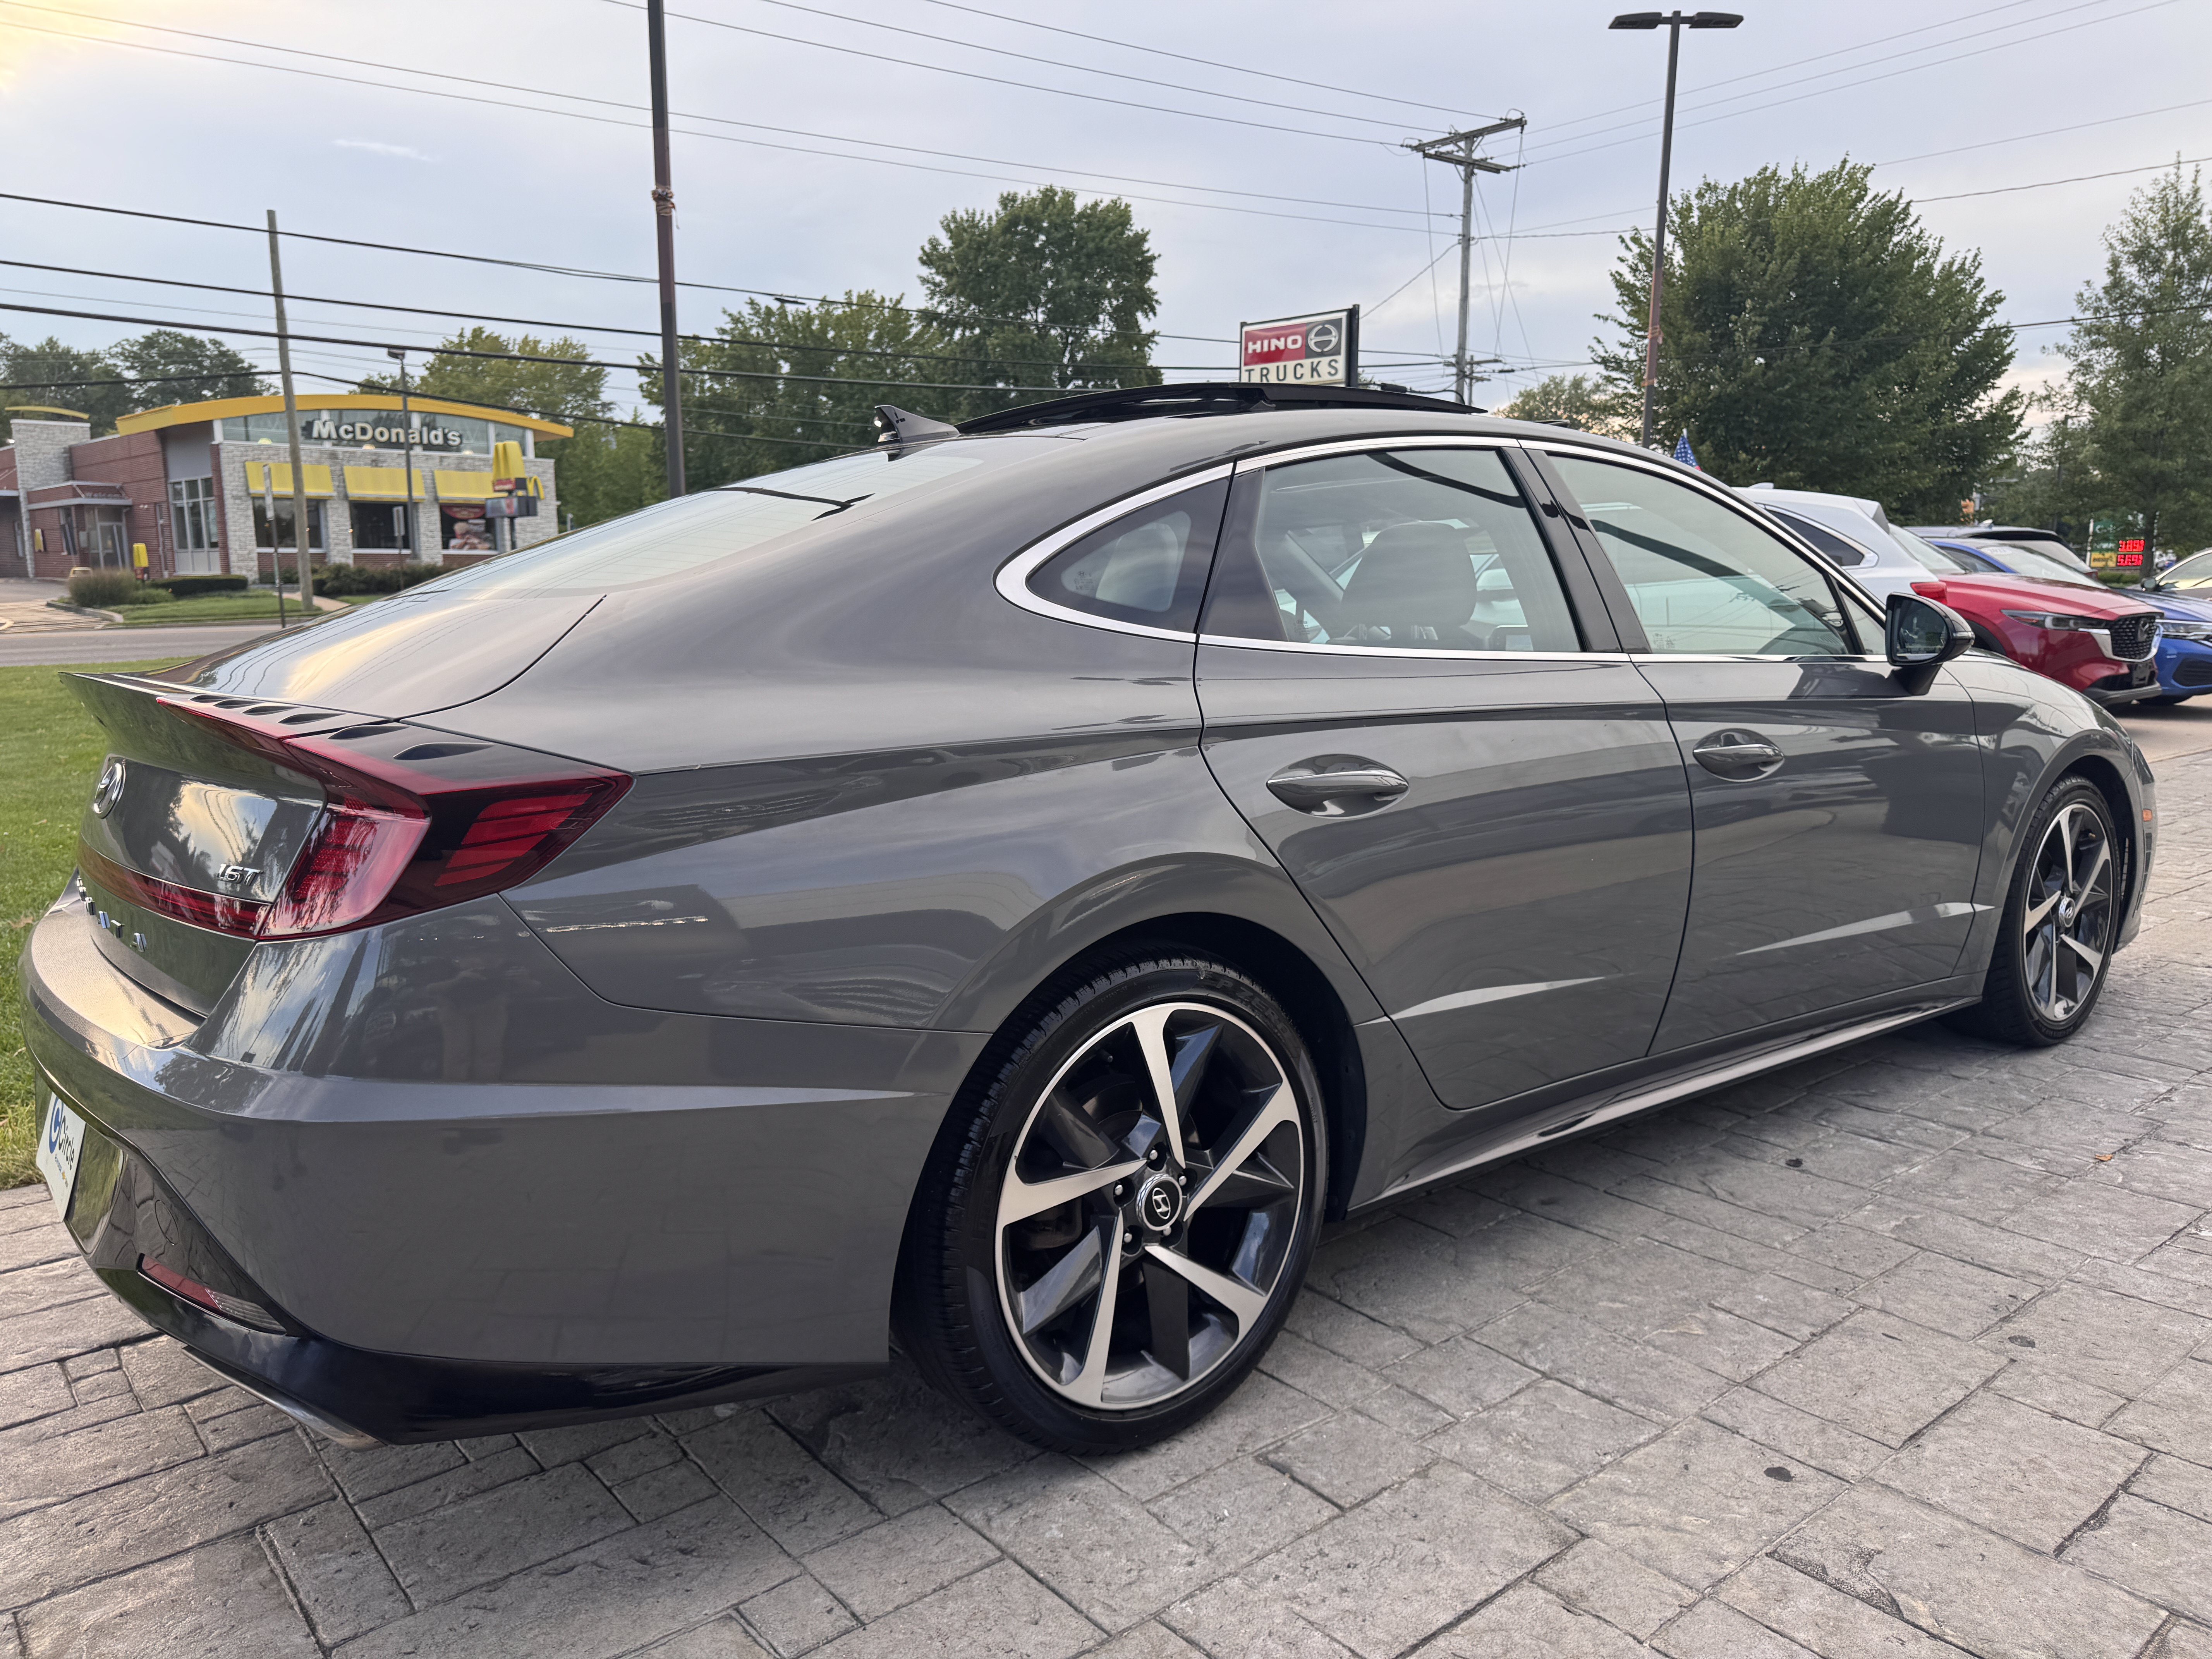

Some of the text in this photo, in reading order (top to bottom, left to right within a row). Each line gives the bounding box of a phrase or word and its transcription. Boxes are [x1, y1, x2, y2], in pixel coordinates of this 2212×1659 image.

[1247, 335, 1302, 354] HINO
[1245, 359, 1338, 383] TRUCKS
[311, 419, 462, 447] McDonald's
[58, 1115, 74, 1171] Circle
